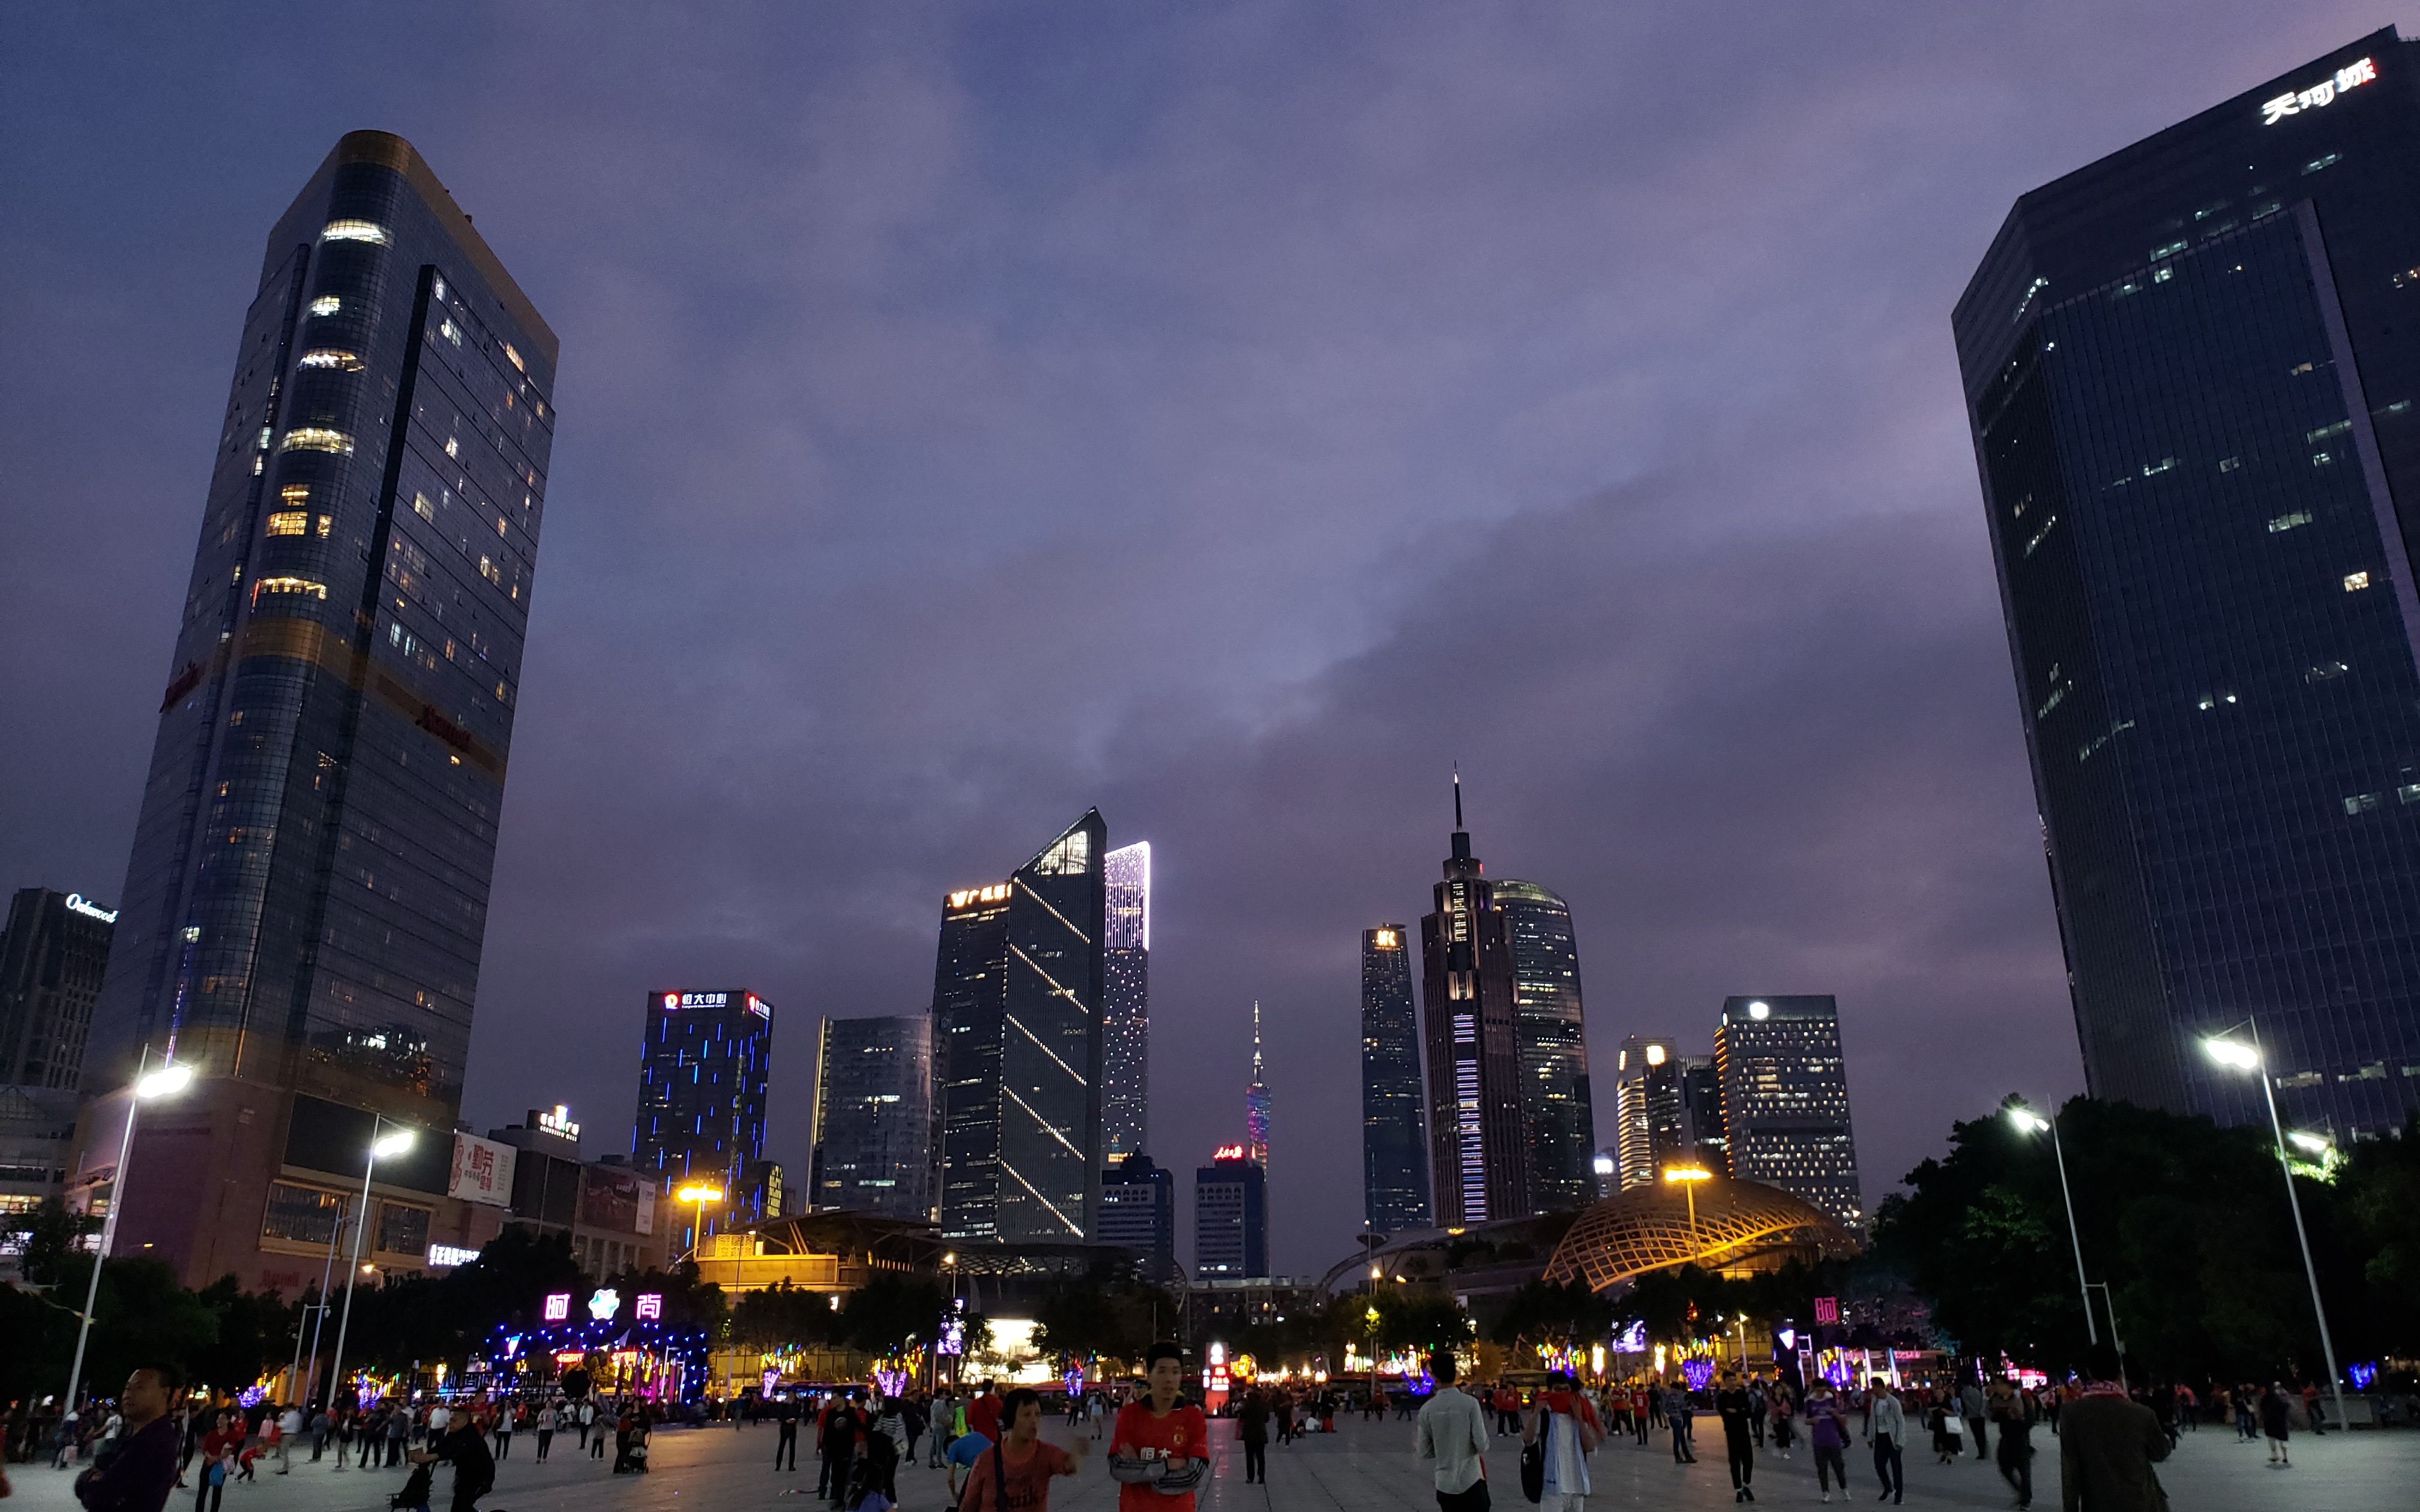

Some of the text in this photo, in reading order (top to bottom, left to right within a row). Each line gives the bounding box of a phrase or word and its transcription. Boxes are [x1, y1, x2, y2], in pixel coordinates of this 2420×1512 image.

[544, 1294, 663, 1320] 时 尚
[1815, 1297, 1838, 1321] 时
[1140, 1447, 1172, 1460] 恒大
